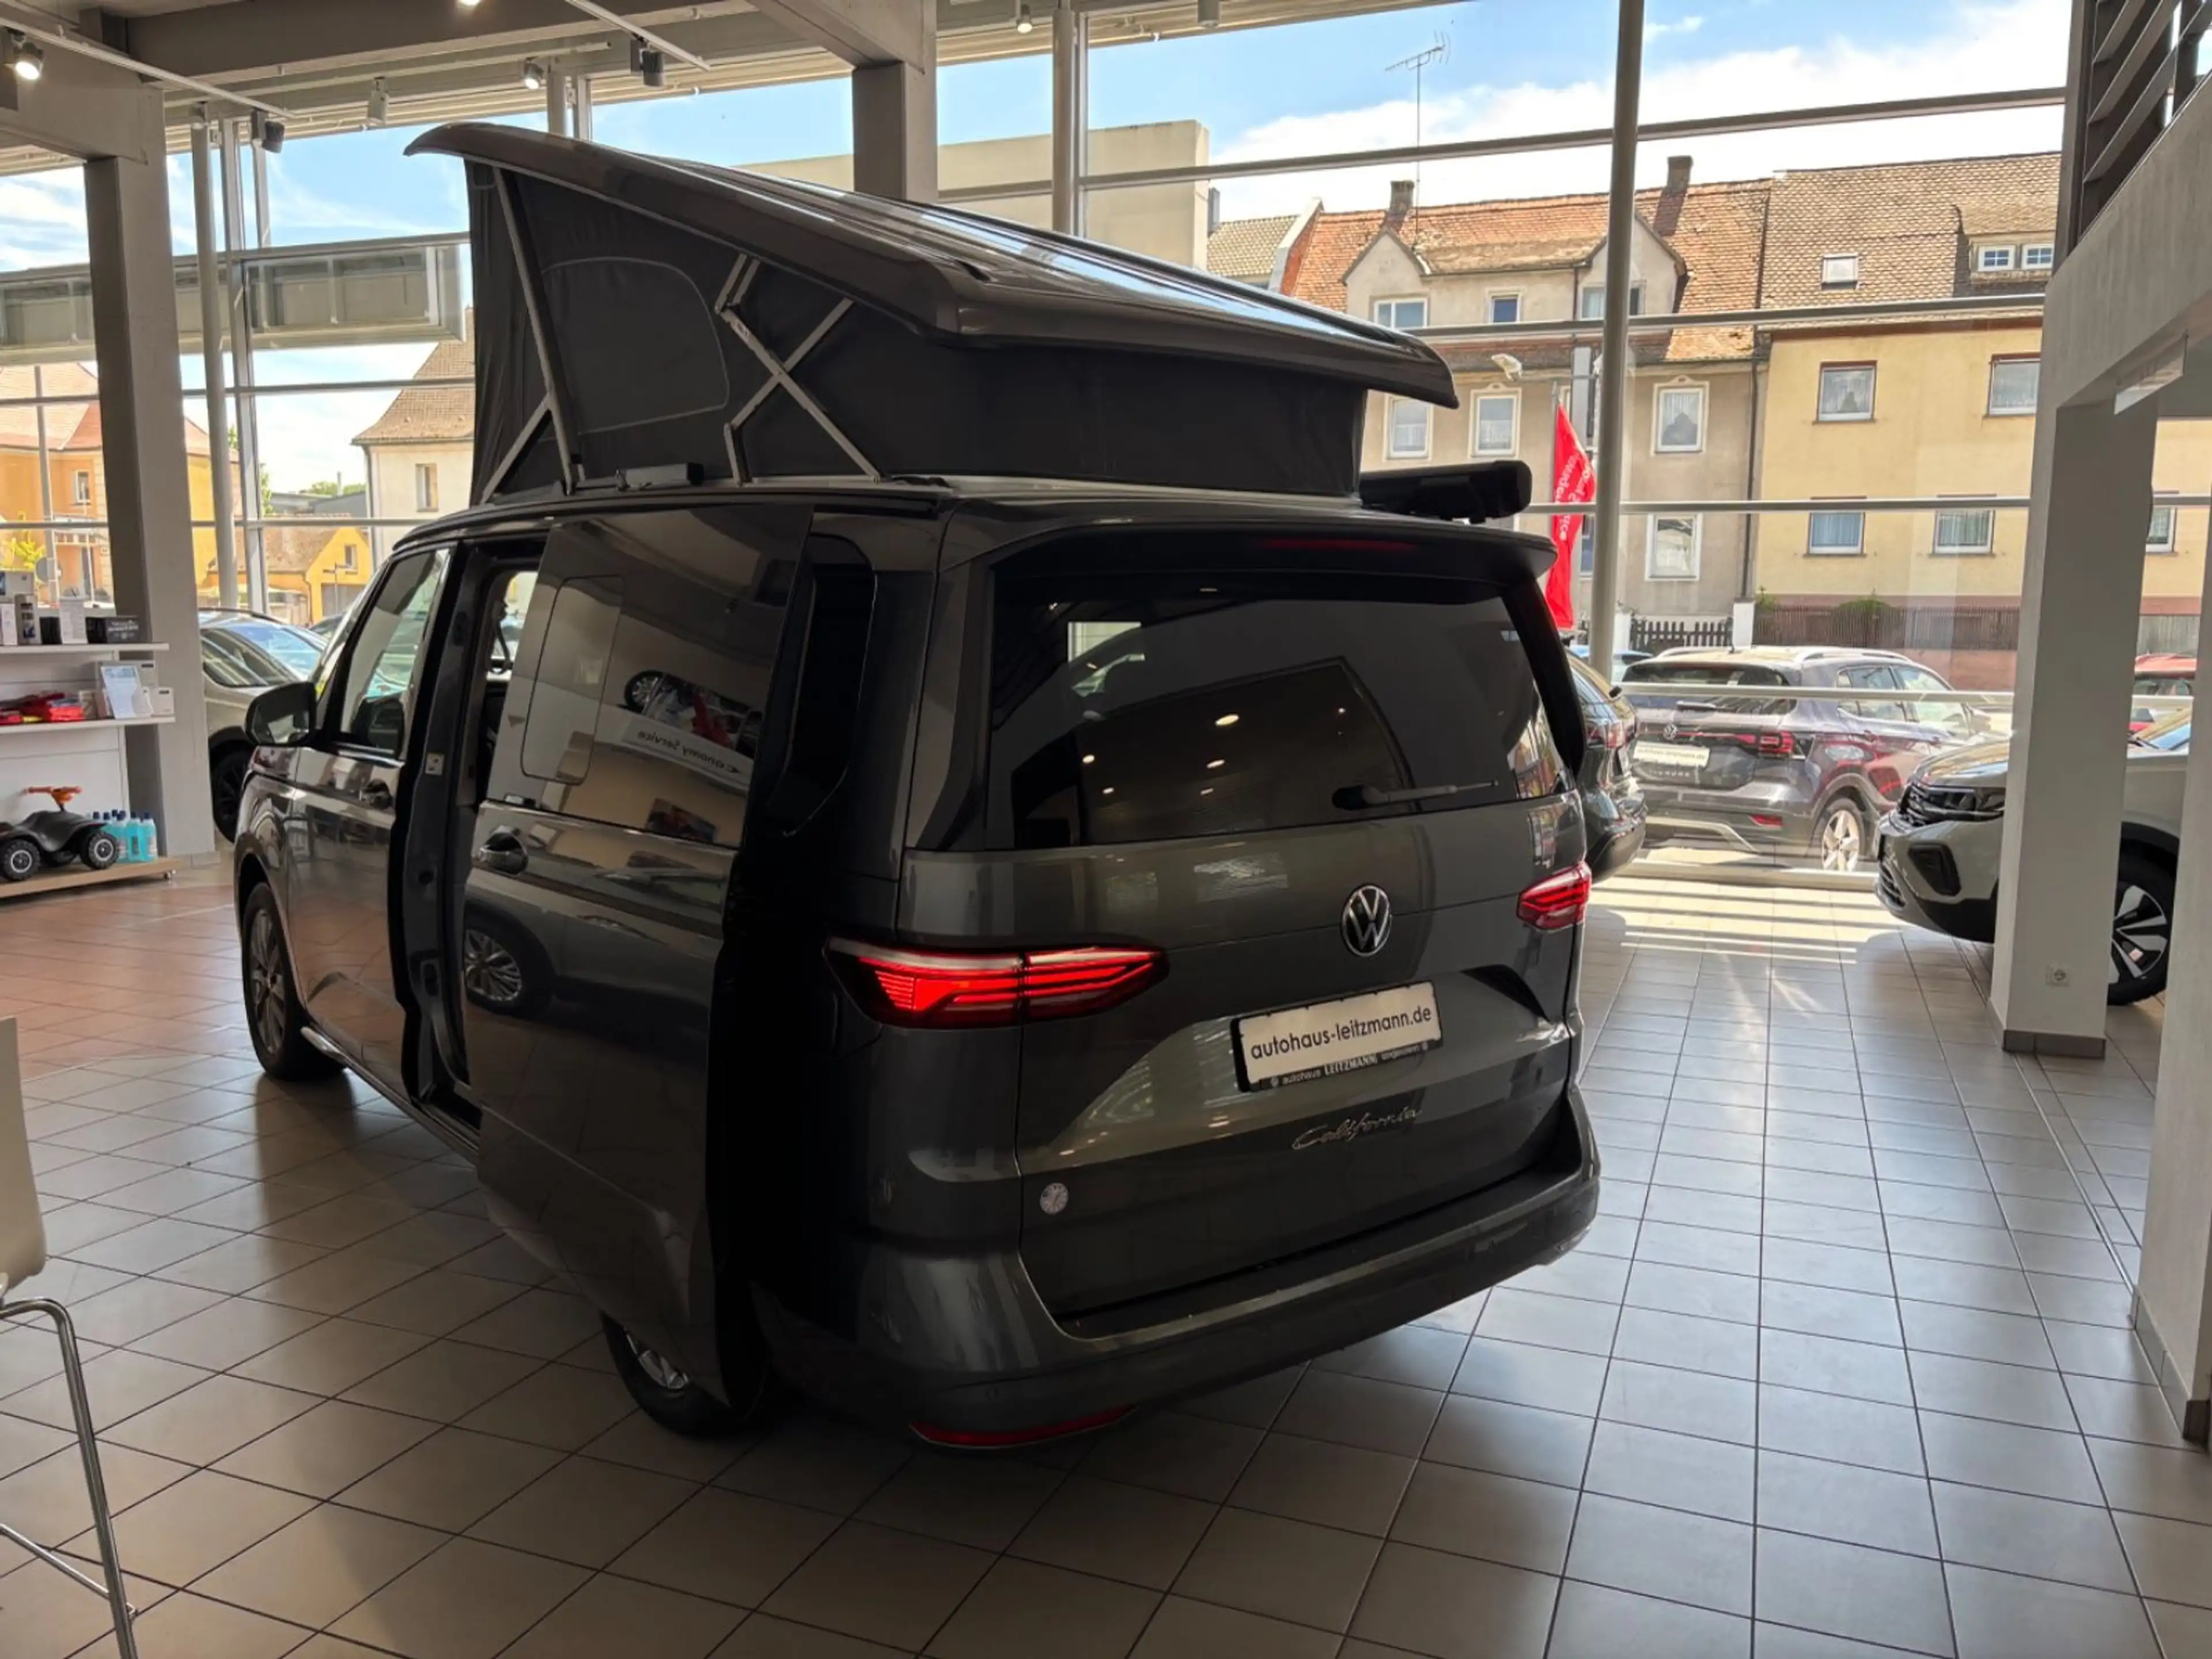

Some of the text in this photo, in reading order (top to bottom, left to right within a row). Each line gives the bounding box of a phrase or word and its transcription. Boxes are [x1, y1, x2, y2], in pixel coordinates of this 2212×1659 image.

[1342, 886, 1391, 956] VW
[1251, 1006, 1432, 1059] autohaus-leitzmann.de
[1292, 1106, 1423, 1150] California
